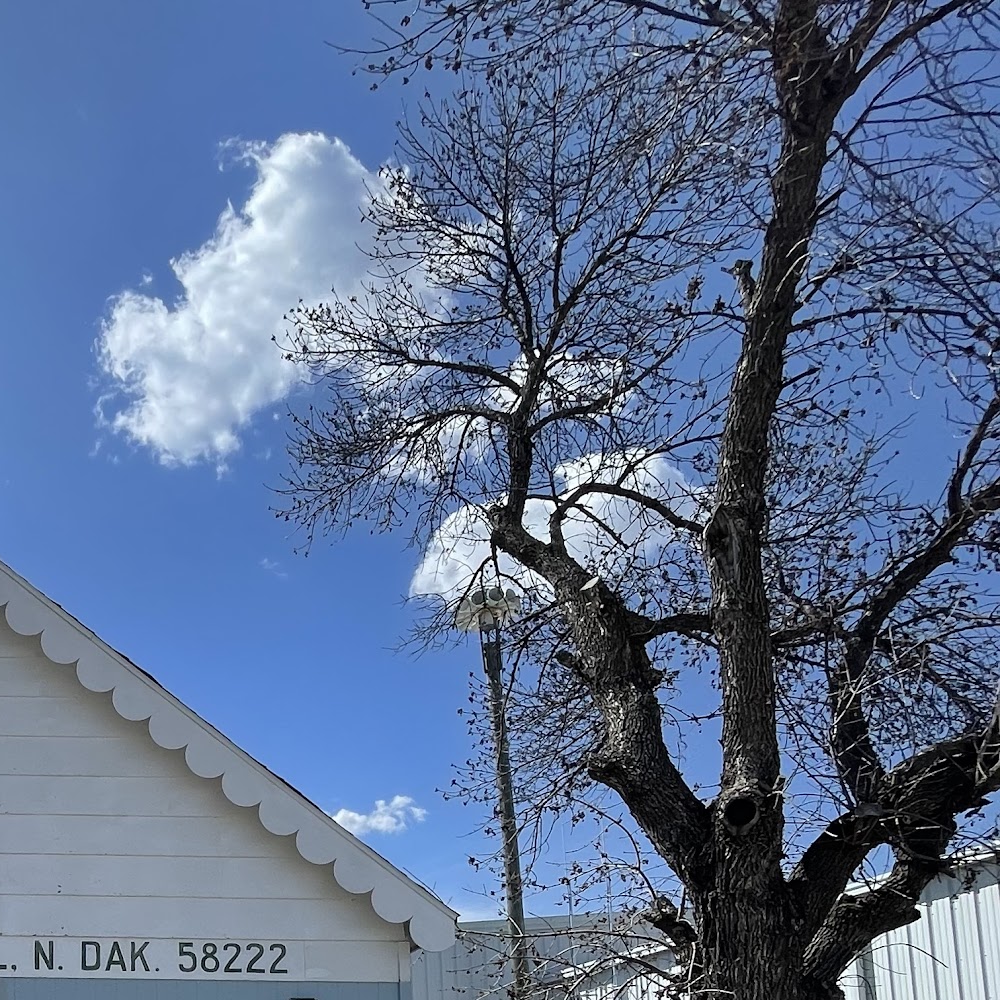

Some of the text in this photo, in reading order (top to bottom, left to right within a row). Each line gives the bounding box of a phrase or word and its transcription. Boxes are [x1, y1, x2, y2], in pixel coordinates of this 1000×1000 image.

[34, 940, 64, 970] N.
[81, 941, 160, 972] DAK.
[178, 942, 288, 974] 58222
